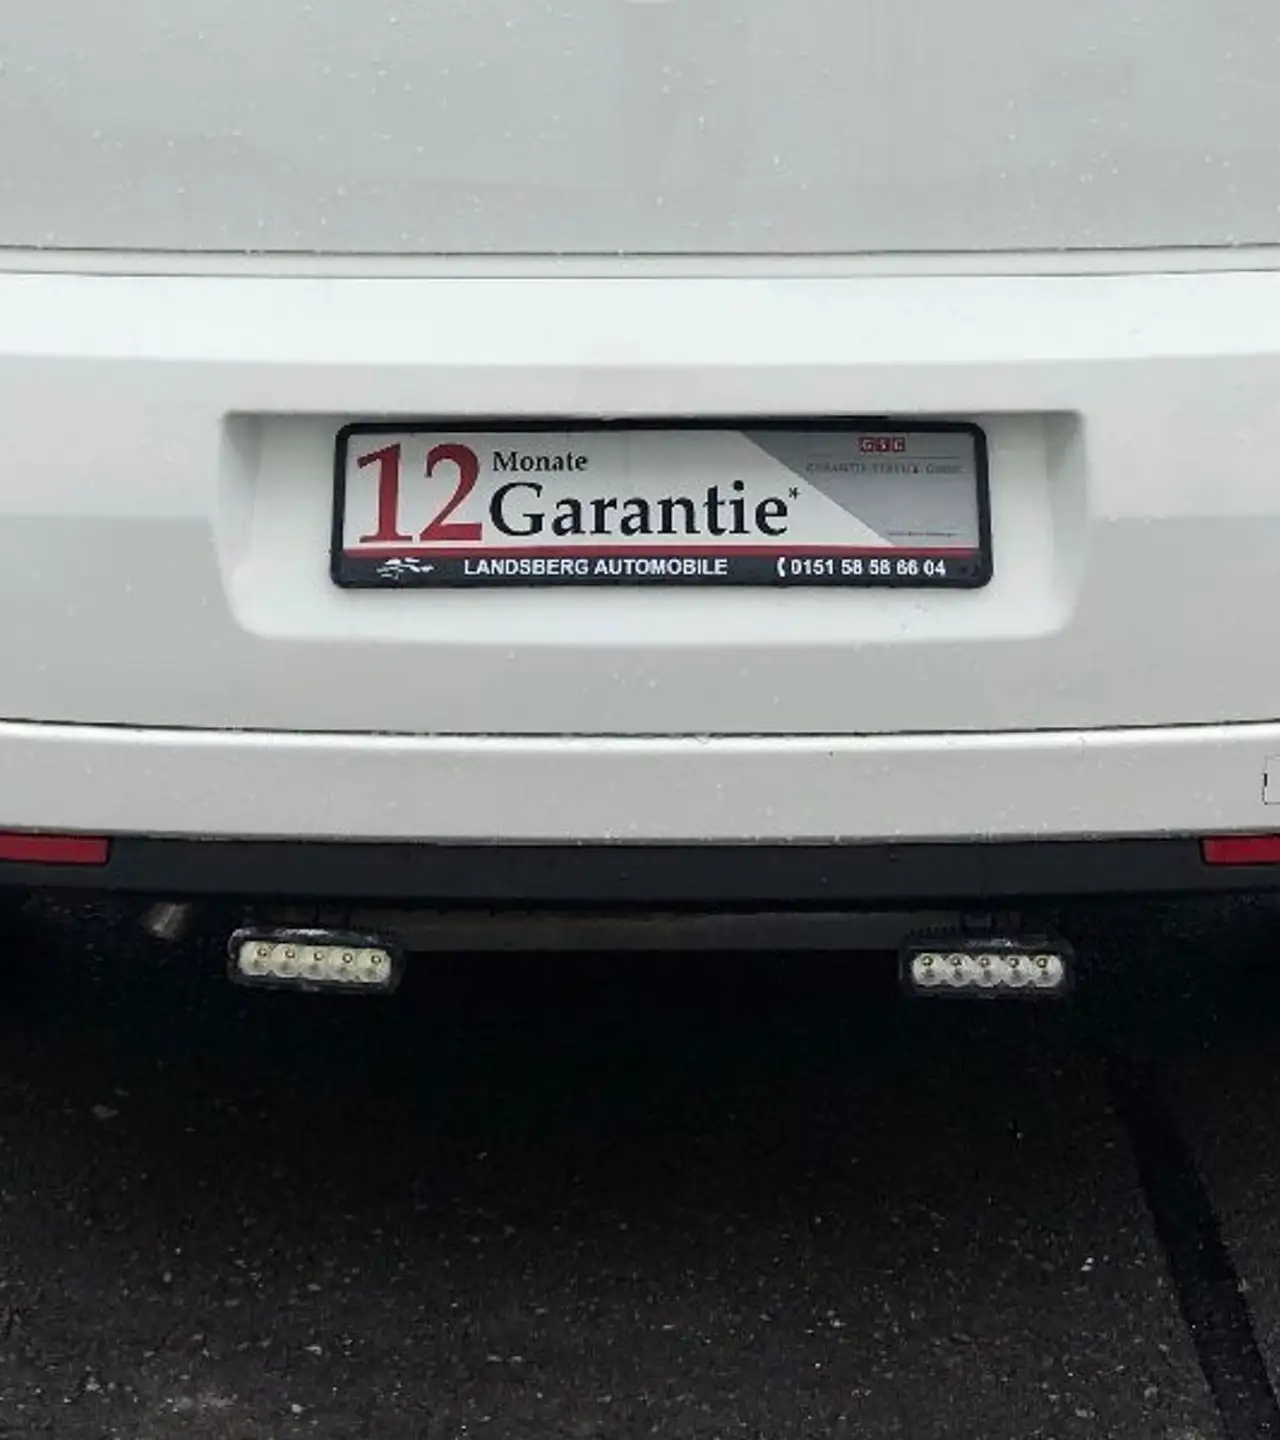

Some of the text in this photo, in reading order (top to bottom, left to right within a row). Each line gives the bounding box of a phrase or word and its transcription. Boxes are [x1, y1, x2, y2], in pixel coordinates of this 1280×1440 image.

[493, 450, 589, 471] Monate
[357, 442, 482, 543] 12
[464, 559, 728, 576] LANDSBERG AUTOMOBILE
[791, 559, 835, 576] 0151
[923, 559, 947, 578] 04
